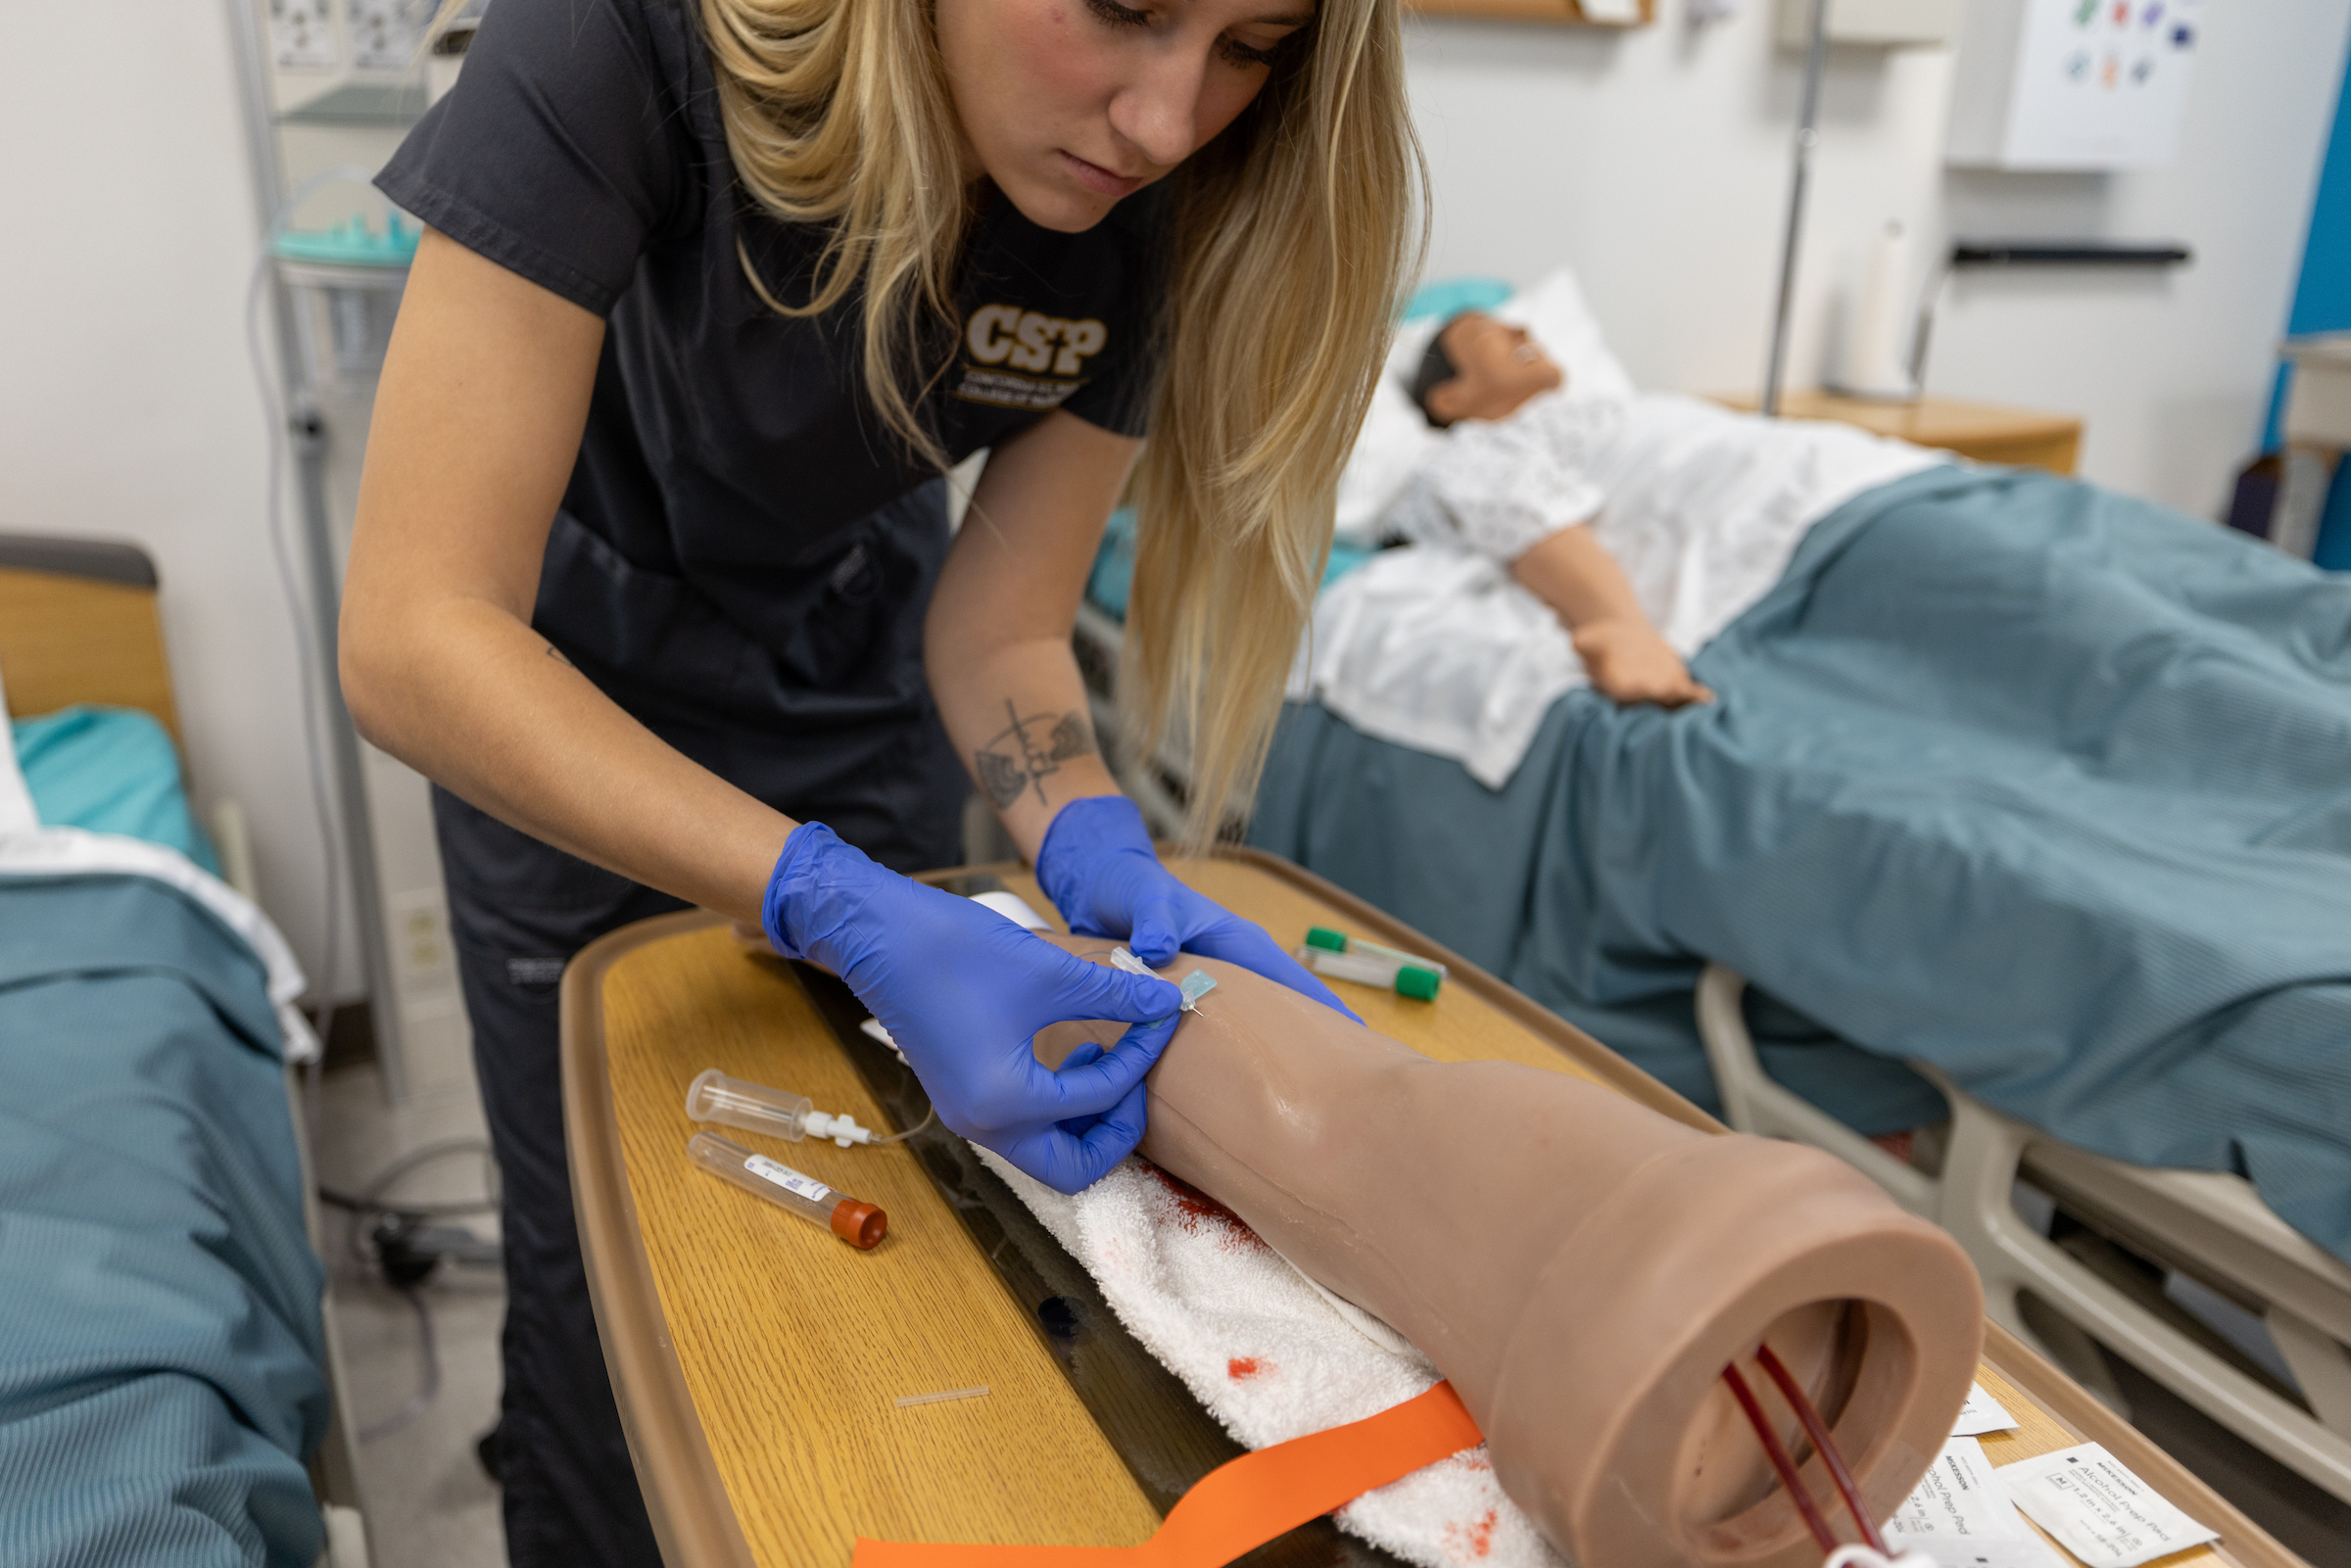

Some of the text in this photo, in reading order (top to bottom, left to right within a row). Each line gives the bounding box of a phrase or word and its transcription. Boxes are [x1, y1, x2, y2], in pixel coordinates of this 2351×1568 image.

[967, 304, 1108, 375] CSP
[1940, 1492, 1957, 1514] Prep
[1951, 1515, 1971, 1535] Pad
[2078, 1467, 2122, 1500] Alcohol
[2120, 1500, 2145, 1522] Prep
[2146, 1522, 2171, 1542] Pad
